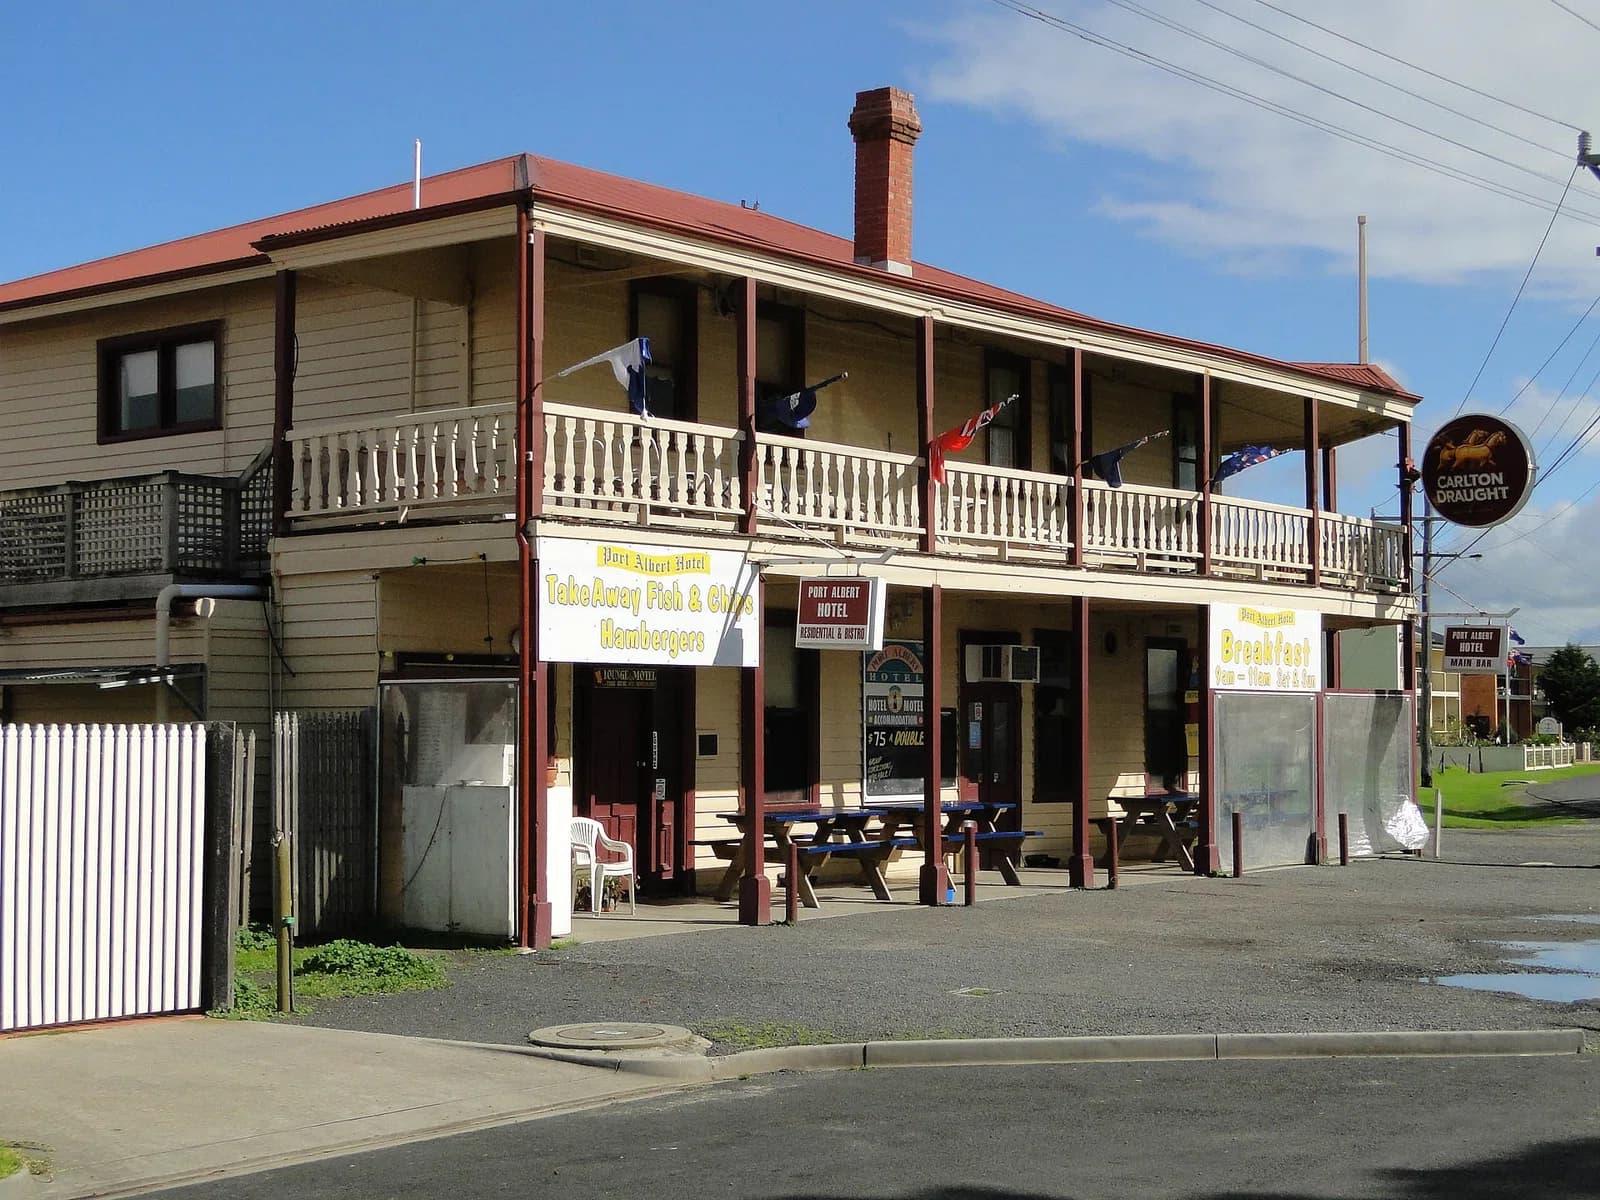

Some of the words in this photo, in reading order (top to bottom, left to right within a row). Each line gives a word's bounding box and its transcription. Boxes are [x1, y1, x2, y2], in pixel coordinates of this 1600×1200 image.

[1437, 471, 1504, 490] CARLTON
[1436, 486, 1509, 504] DRAUGHT
[603, 546, 629, 565] Port
[635, 554, 671, 572] Albert
[675, 556, 705, 571] Hotel
[545, 574, 641, 616] TakeAway
[647, 580, 683, 611] Fish
[688, 584, 702, 612] &
[707, 584, 753, 621] Chips
[808, 586, 828, 598] PORT
[831, 586, 860, 598] ALBERT
[817, 603, 848, 618] HOTEL
[600, 618, 705, 658] Hambergers
[800, 627, 835, 639] RESIDENTIAL
[837, 628, 842, 639] &
[844, 628, 865, 640] BISTRO
[1452, 631, 1468, 640] PORT
[1471, 631, 1494, 640] ALBERT
[1221, 629, 1311, 667] Breakfast
[1459, 642, 1484, 652] HOTEL
[1450, 658, 1472, 667] MAIN
[1476, 659, 1492, 667] BAR
[603, 669, 628, 681] LOUNGE
[632, 670, 657, 681] MOTEL
[869, 673, 922, 683] HOTEL
[1215, 664, 1236, 686] 9am
[1248, 665, 1272, 687] 11am
[1292, 668, 1300, 688] &
[1301, 668, 1317, 688] Sun
[868, 698, 887, 712] HOTEL
[903, 699, 924, 712] MOTEL
[873, 714, 918, 726] ACCOMMODATION
[868, 731, 887, 747] $75
[894, 730, 925, 747] DOUBLE
